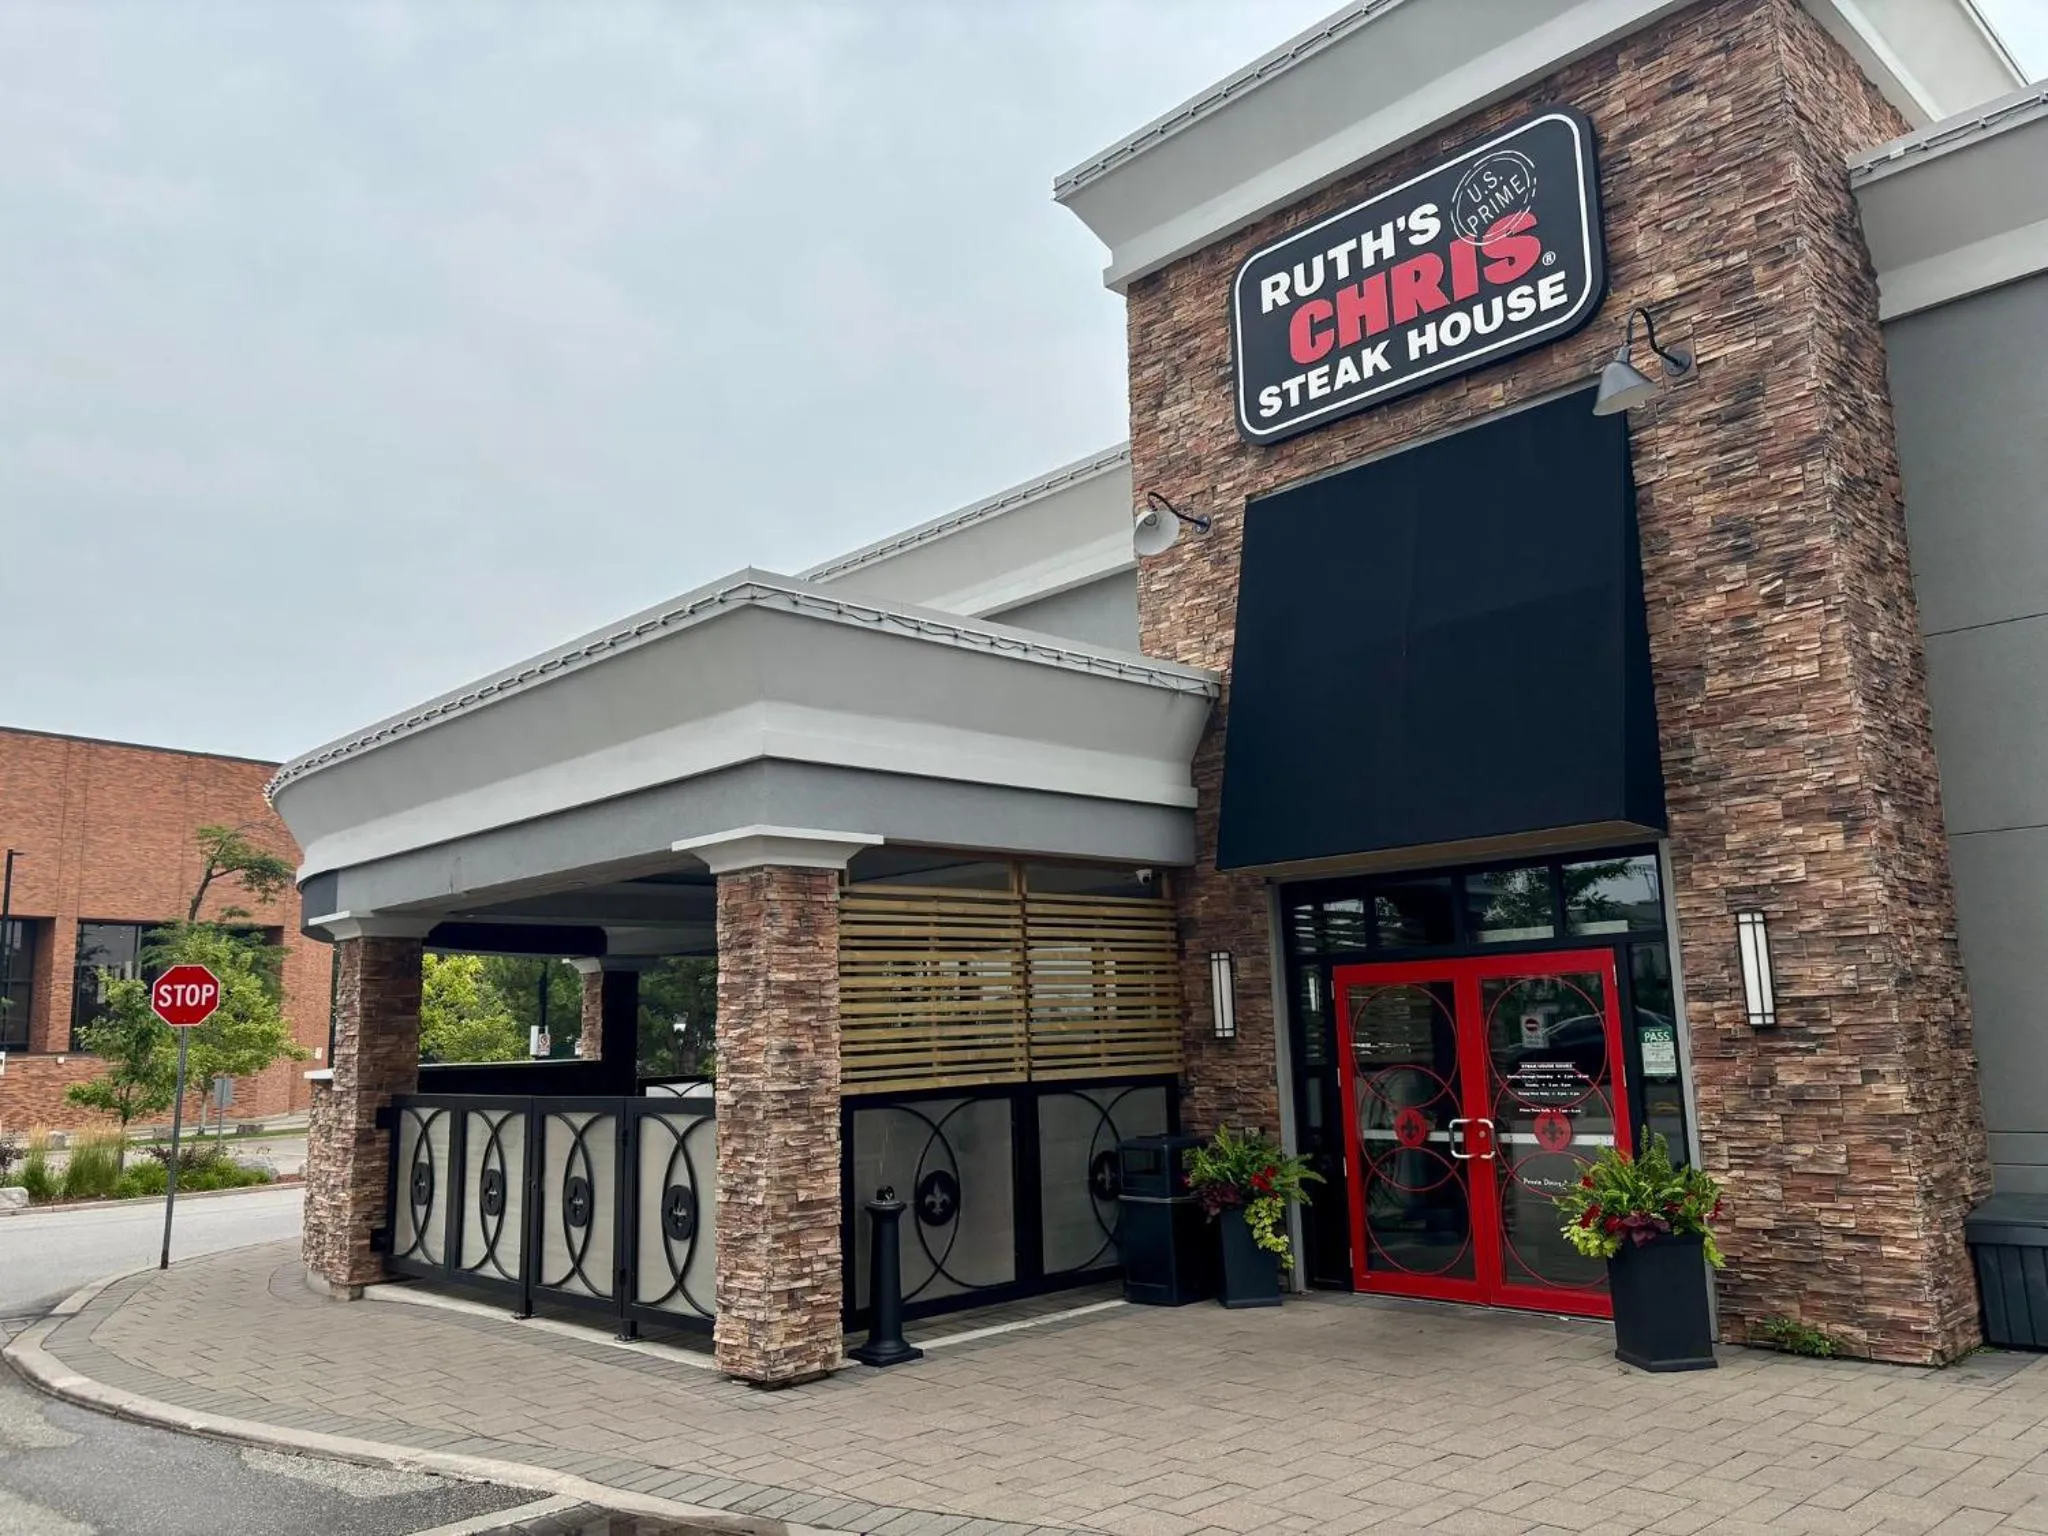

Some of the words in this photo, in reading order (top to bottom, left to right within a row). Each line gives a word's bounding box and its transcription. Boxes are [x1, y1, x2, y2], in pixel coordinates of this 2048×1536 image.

[1467, 171, 1503, 203] U.S.
[1467, 174, 1526, 234] PRIME
[1260, 203, 1442, 314] RUTH'S
[1289, 211, 1542, 365] CHRIS
[1259, 340, 1393, 418] STEAK
[1406, 270, 1568, 361] HOUSE
[158, 984, 215, 1007] STOP
[1644, 1031, 1671, 1042] PASS
